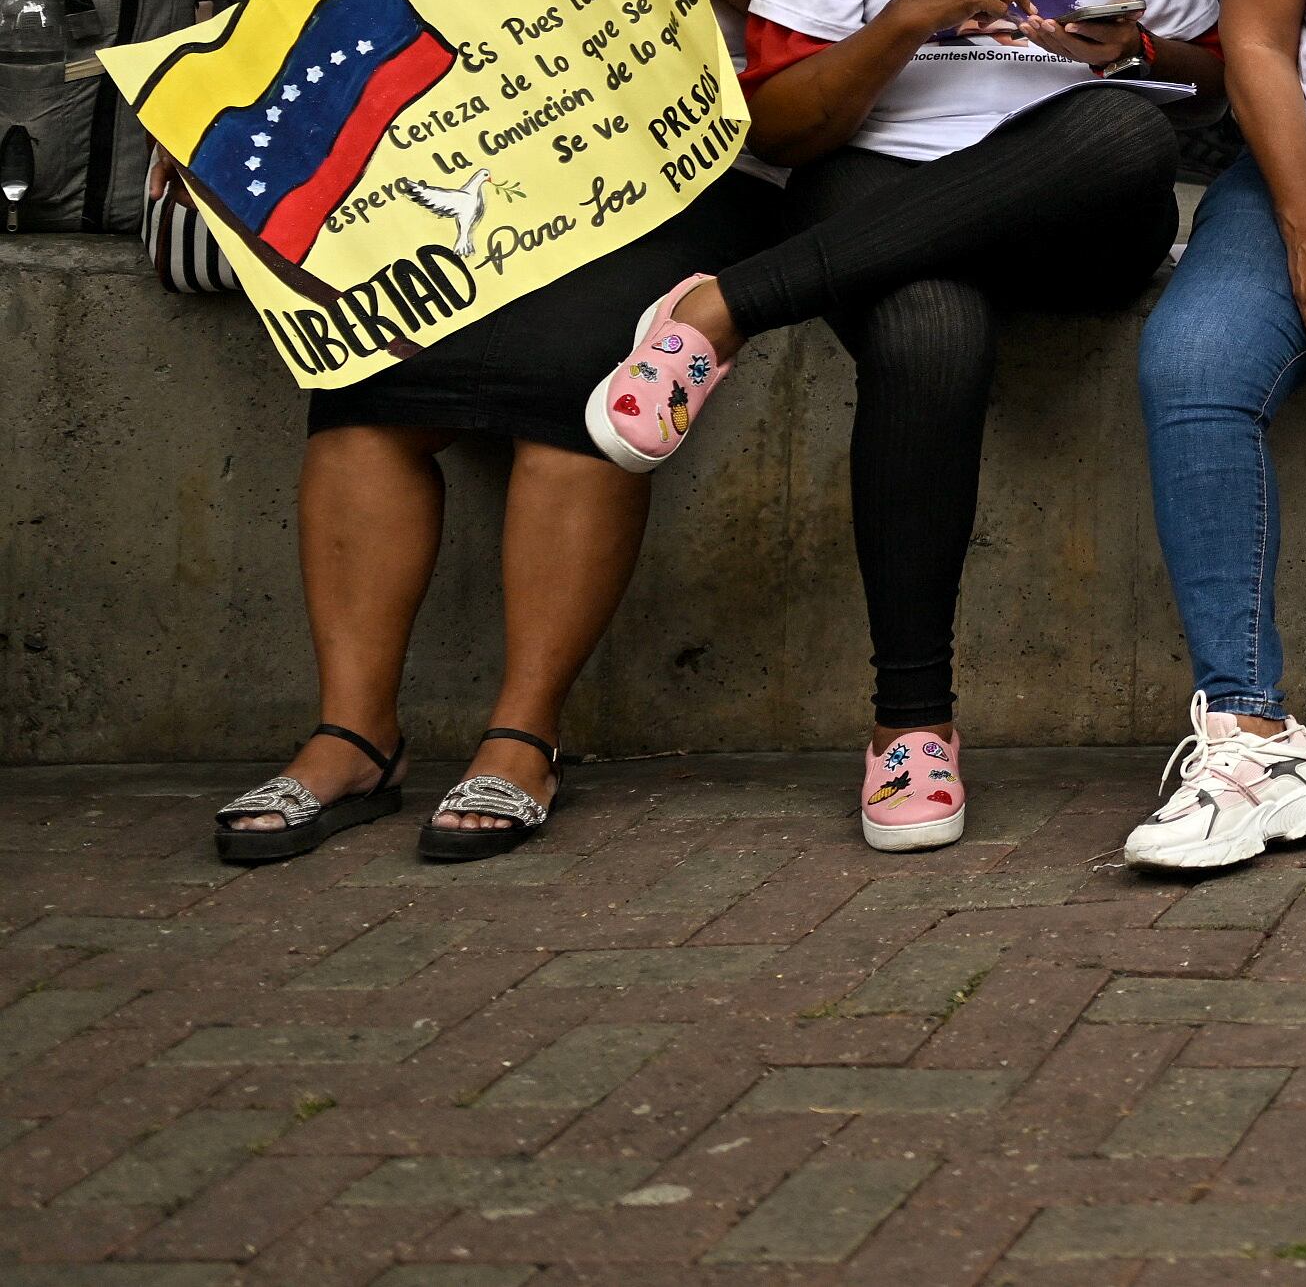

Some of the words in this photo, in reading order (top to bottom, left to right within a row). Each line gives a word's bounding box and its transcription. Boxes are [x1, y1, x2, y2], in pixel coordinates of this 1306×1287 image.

[388, 93, 490, 151] Certeza
[500, 72, 532, 100] de
[534, 54, 570, 78] lo
[581, 19, 620, 62] que
[500, 6, 564, 46] Pues
[431, 151, 474, 175] la
[605, 61, 633, 91] de
[628, 40, 656, 66] lo
[263, 244, 478, 376] LIBERTAD
